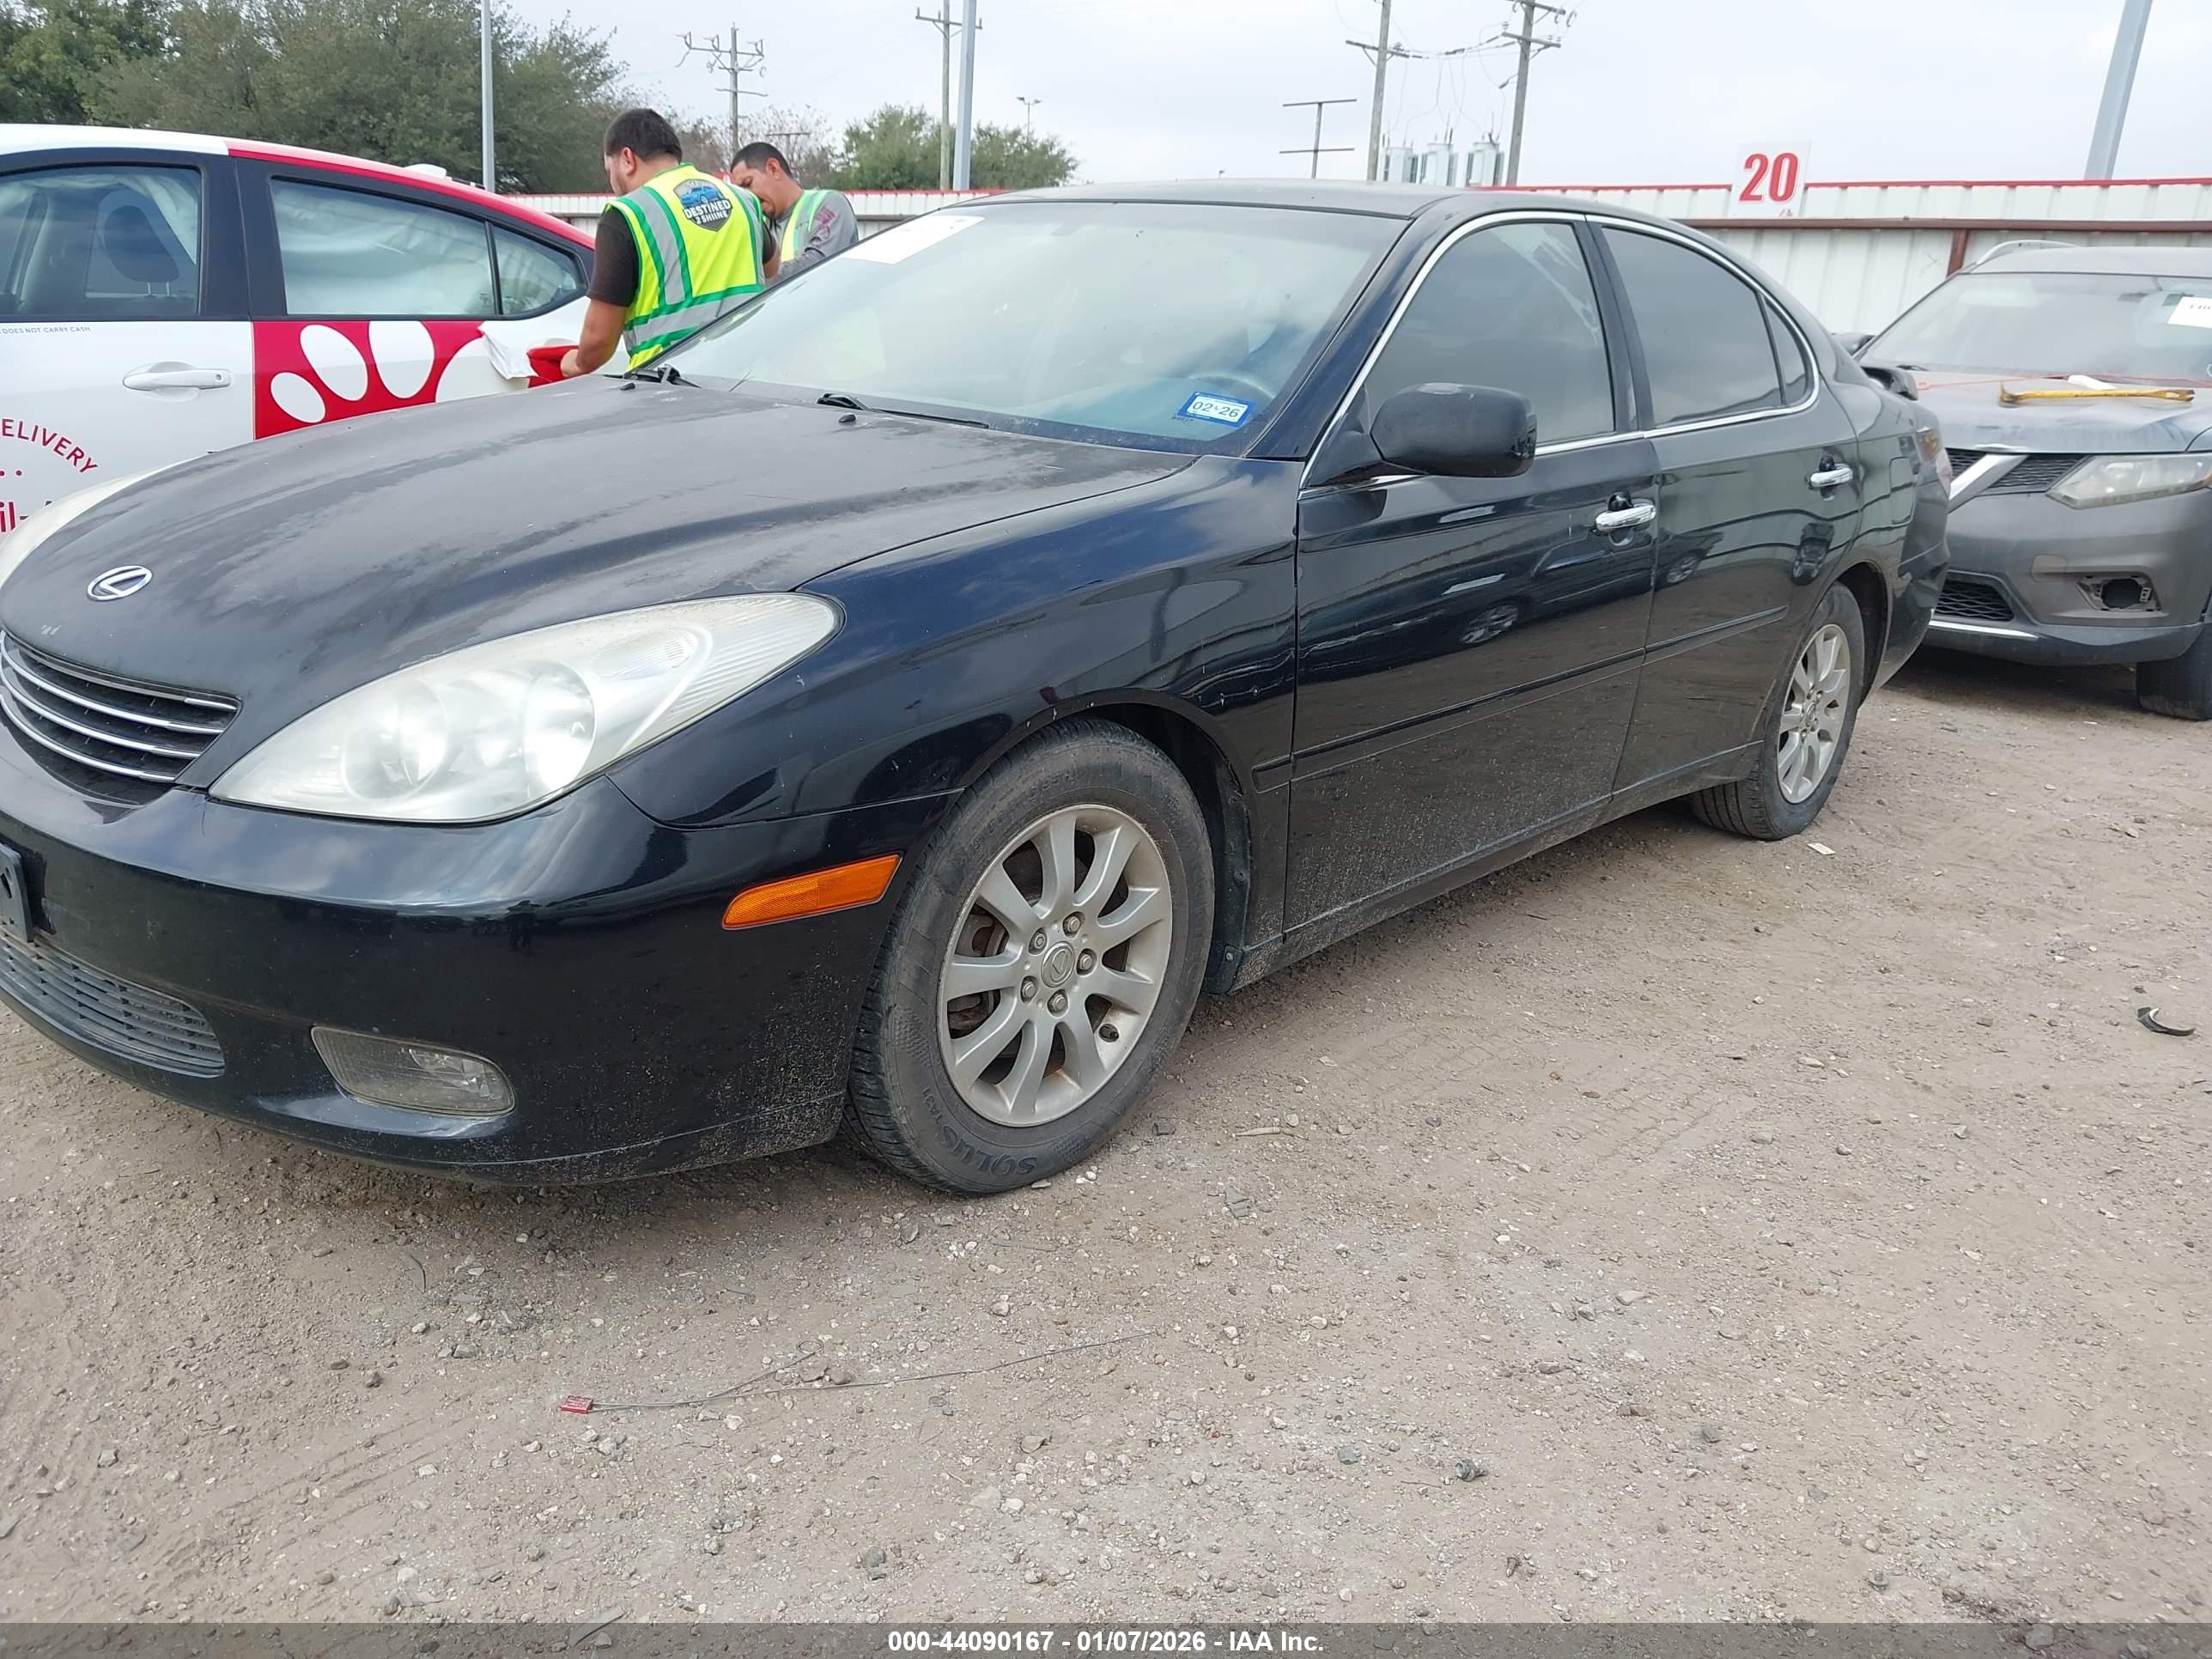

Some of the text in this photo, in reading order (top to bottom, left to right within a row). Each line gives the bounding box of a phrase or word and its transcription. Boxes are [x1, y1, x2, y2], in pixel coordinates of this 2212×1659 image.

[1740, 153, 1798, 202] 20
[684, 199, 732, 219] DESTINED
[696, 216, 702, 225] 2
[941, 1124, 1039, 1176] SOLUS
